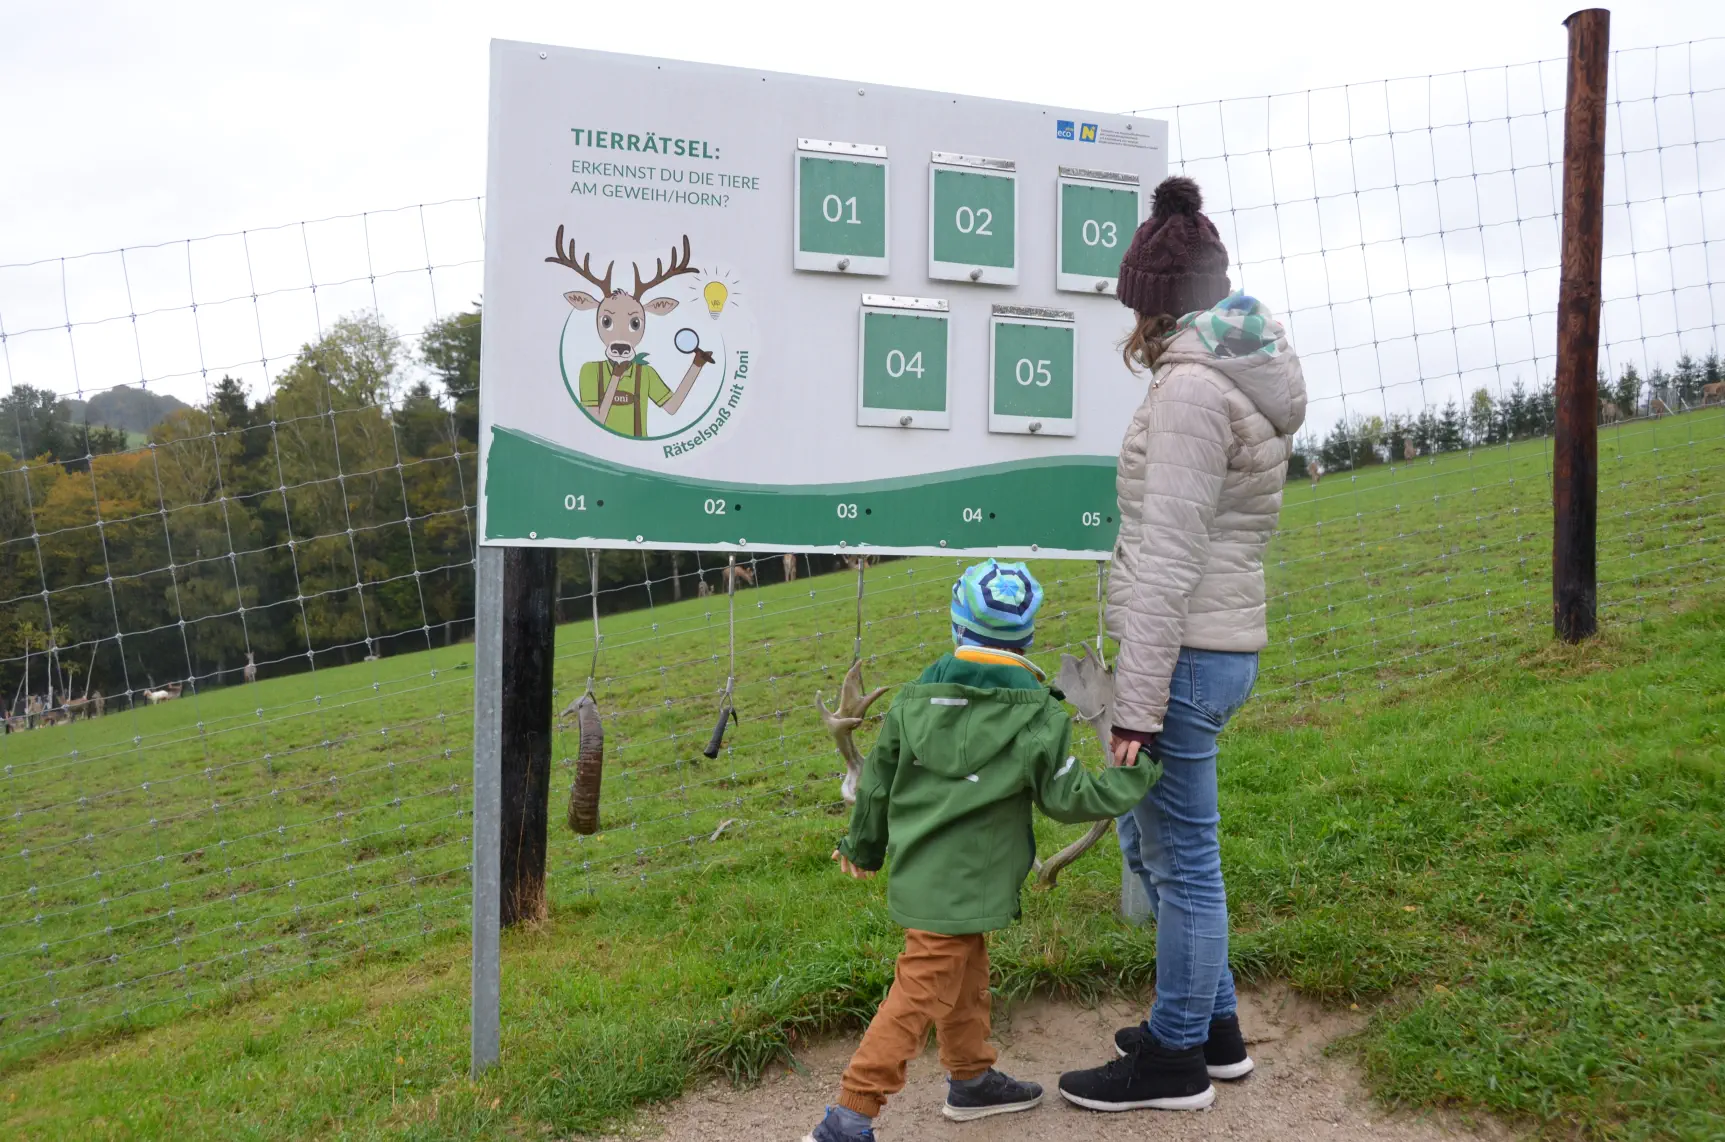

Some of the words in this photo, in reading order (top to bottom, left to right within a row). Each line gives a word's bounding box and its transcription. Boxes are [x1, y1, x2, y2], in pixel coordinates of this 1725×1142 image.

[571, 128, 720, 160] TIERRÄTSEL:
[1057, 130, 1072, 138] eco
[572, 160, 656, 180] ERKENNST
[660, 168, 684, 183] DU
[689, 171, 714, 186] DIE
[718, 174, 760, 190] TIERE
[571, 181, 597, 196] AM
[602, 184, 730, 208] GEWEIH/HORN?
[822, 194, 862, 224] 01
[955, 206, 993, 236] 02
[1082, 219, 1118, 248] 03
[734, 350, 749, 380] Toni
[886, 349, 925, 379] 04
[1015, 358, 1052, 387] 05
[613, 394, 629, 403] oni
[727, 383, 744, 409] mit
[663, 407, 732, 459] Rätselspaß
[564, 494, 587, 511] 01
[704, 498, 726, 515] 02
[837, 503, 858, 519] 03
[962, 507, 983, 524] 04
[1082, 511, 1102, 527] 05
